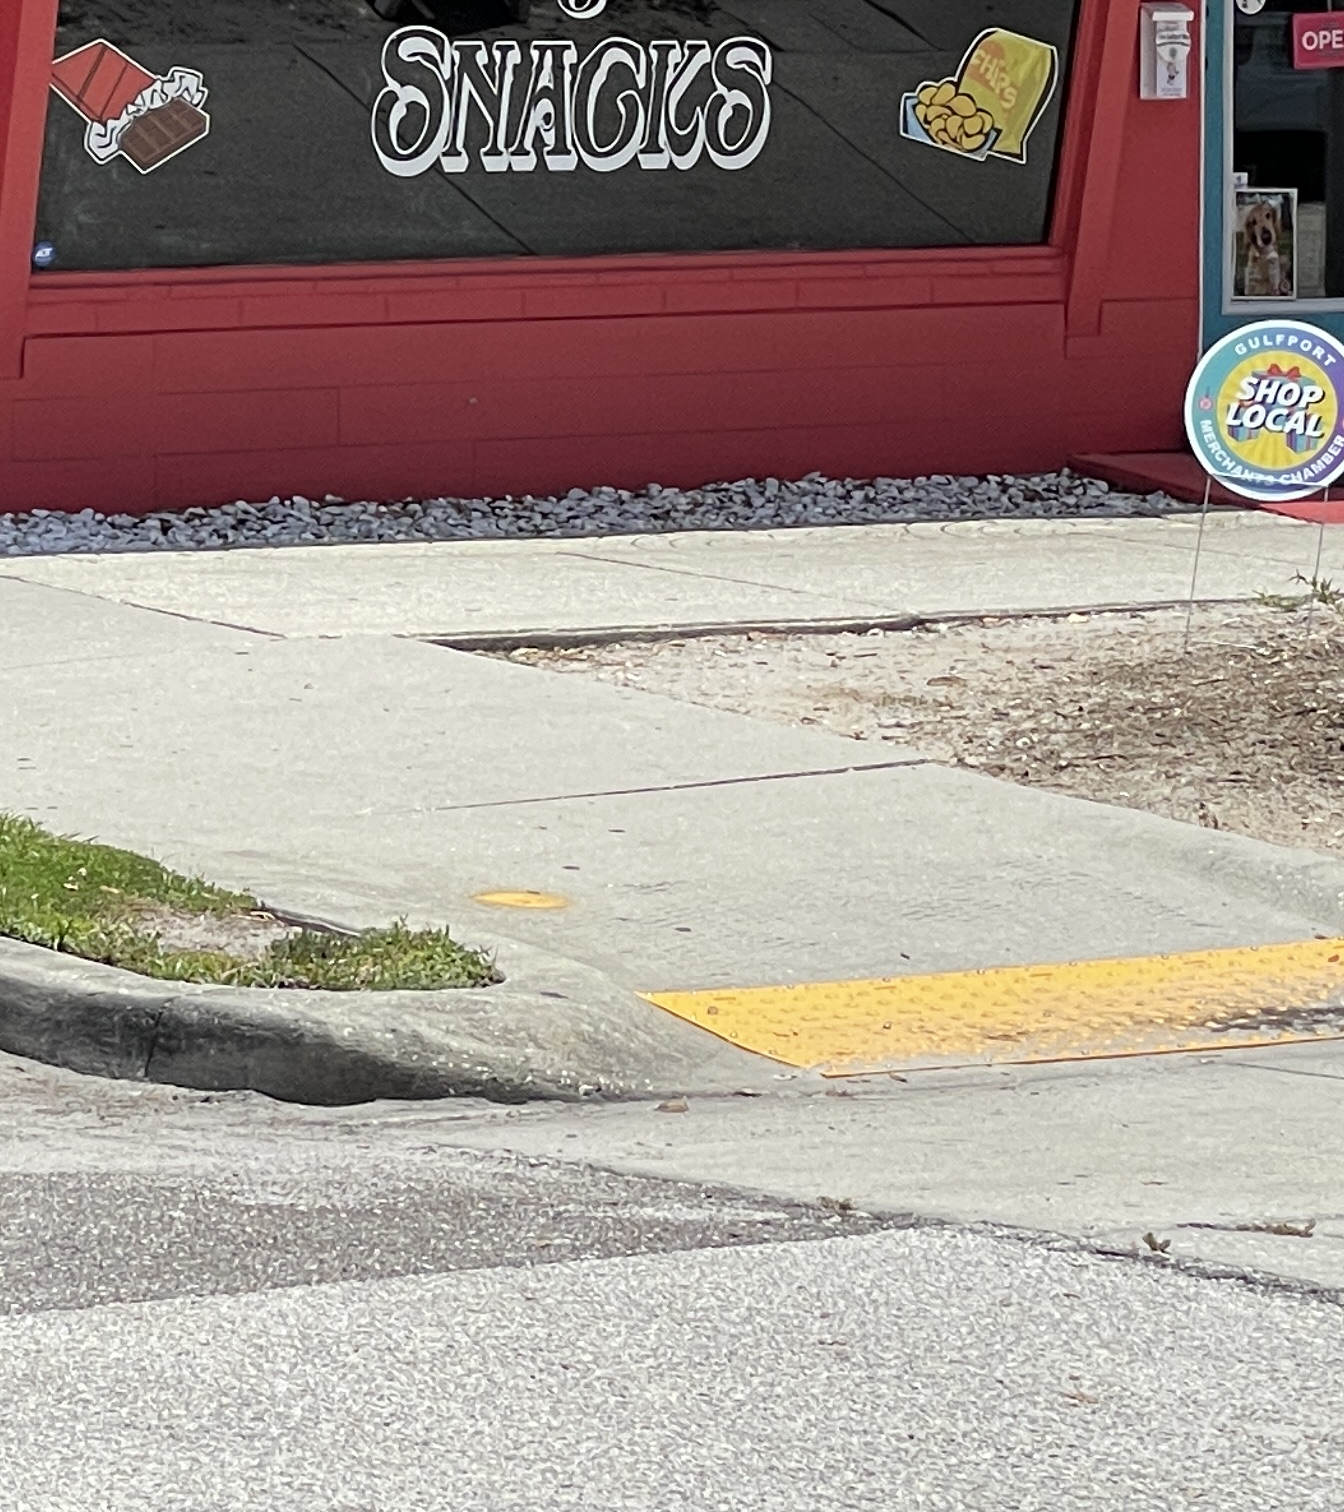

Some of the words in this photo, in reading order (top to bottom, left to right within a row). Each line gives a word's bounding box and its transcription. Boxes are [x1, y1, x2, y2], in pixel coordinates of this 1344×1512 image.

[371, 25, 775, 178] SNACKS
[1234, 333, 1337, 366] GULFPORT
[1236, 375, 1326, 410] SHOP
[1225, 402, 1325, 438] LOCAL
